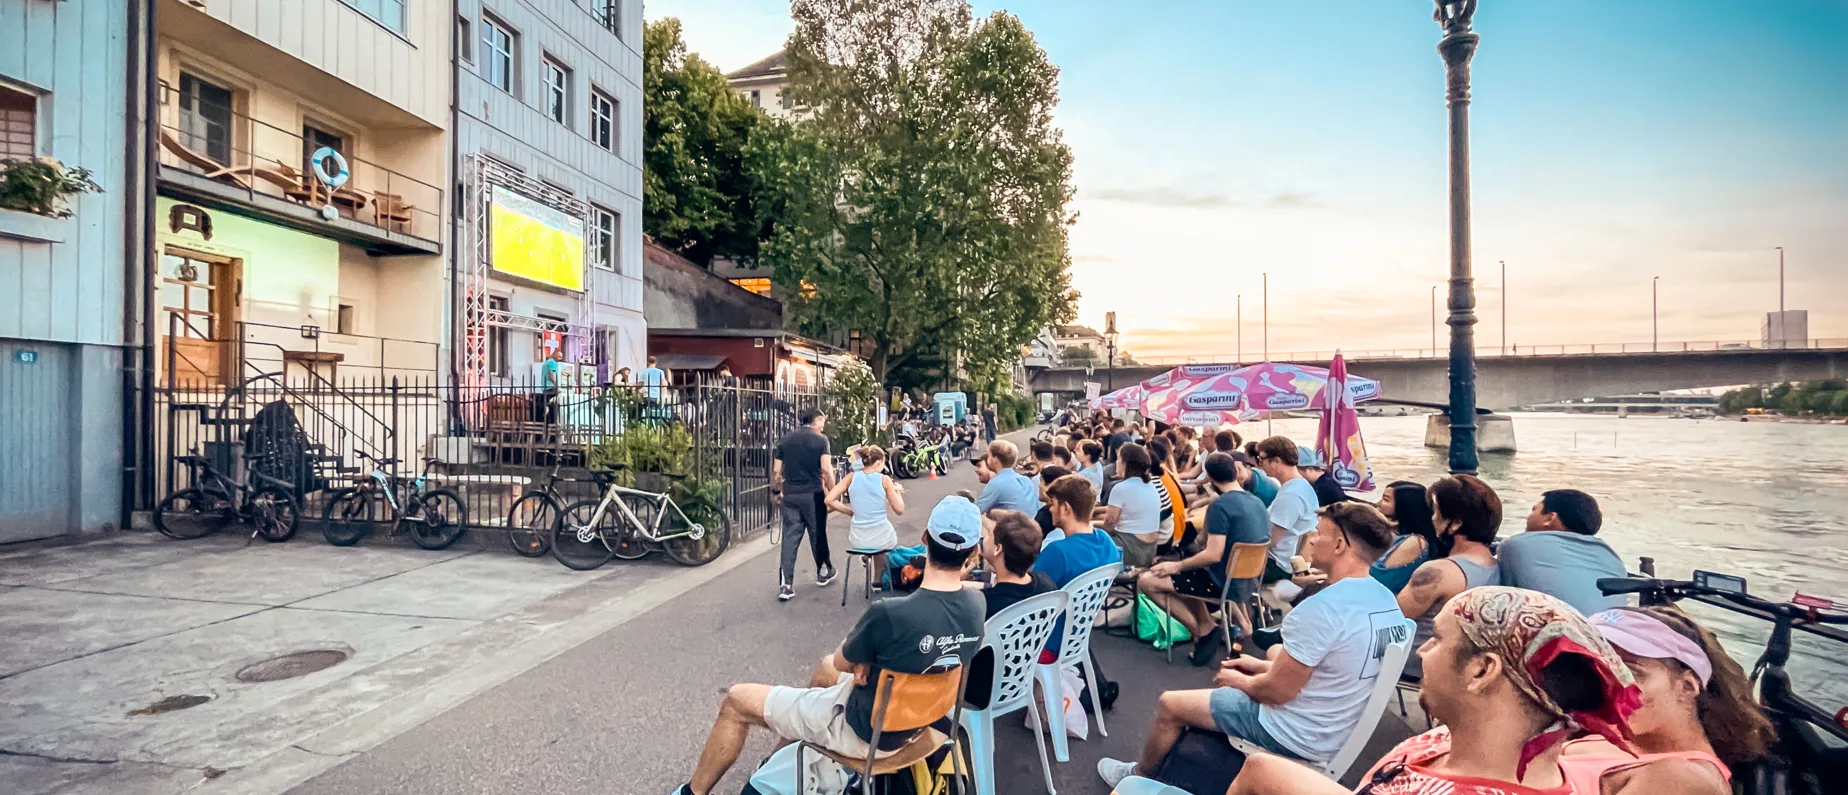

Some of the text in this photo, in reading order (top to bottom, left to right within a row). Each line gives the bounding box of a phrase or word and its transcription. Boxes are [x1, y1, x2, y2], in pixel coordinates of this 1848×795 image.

[20, 352, 34, 362] 61
[1188, 395, 1236, 405] Gasparini
[1268, 398, 1305, 406] Gasparini
[936, 635, 954, 650] Alfa
